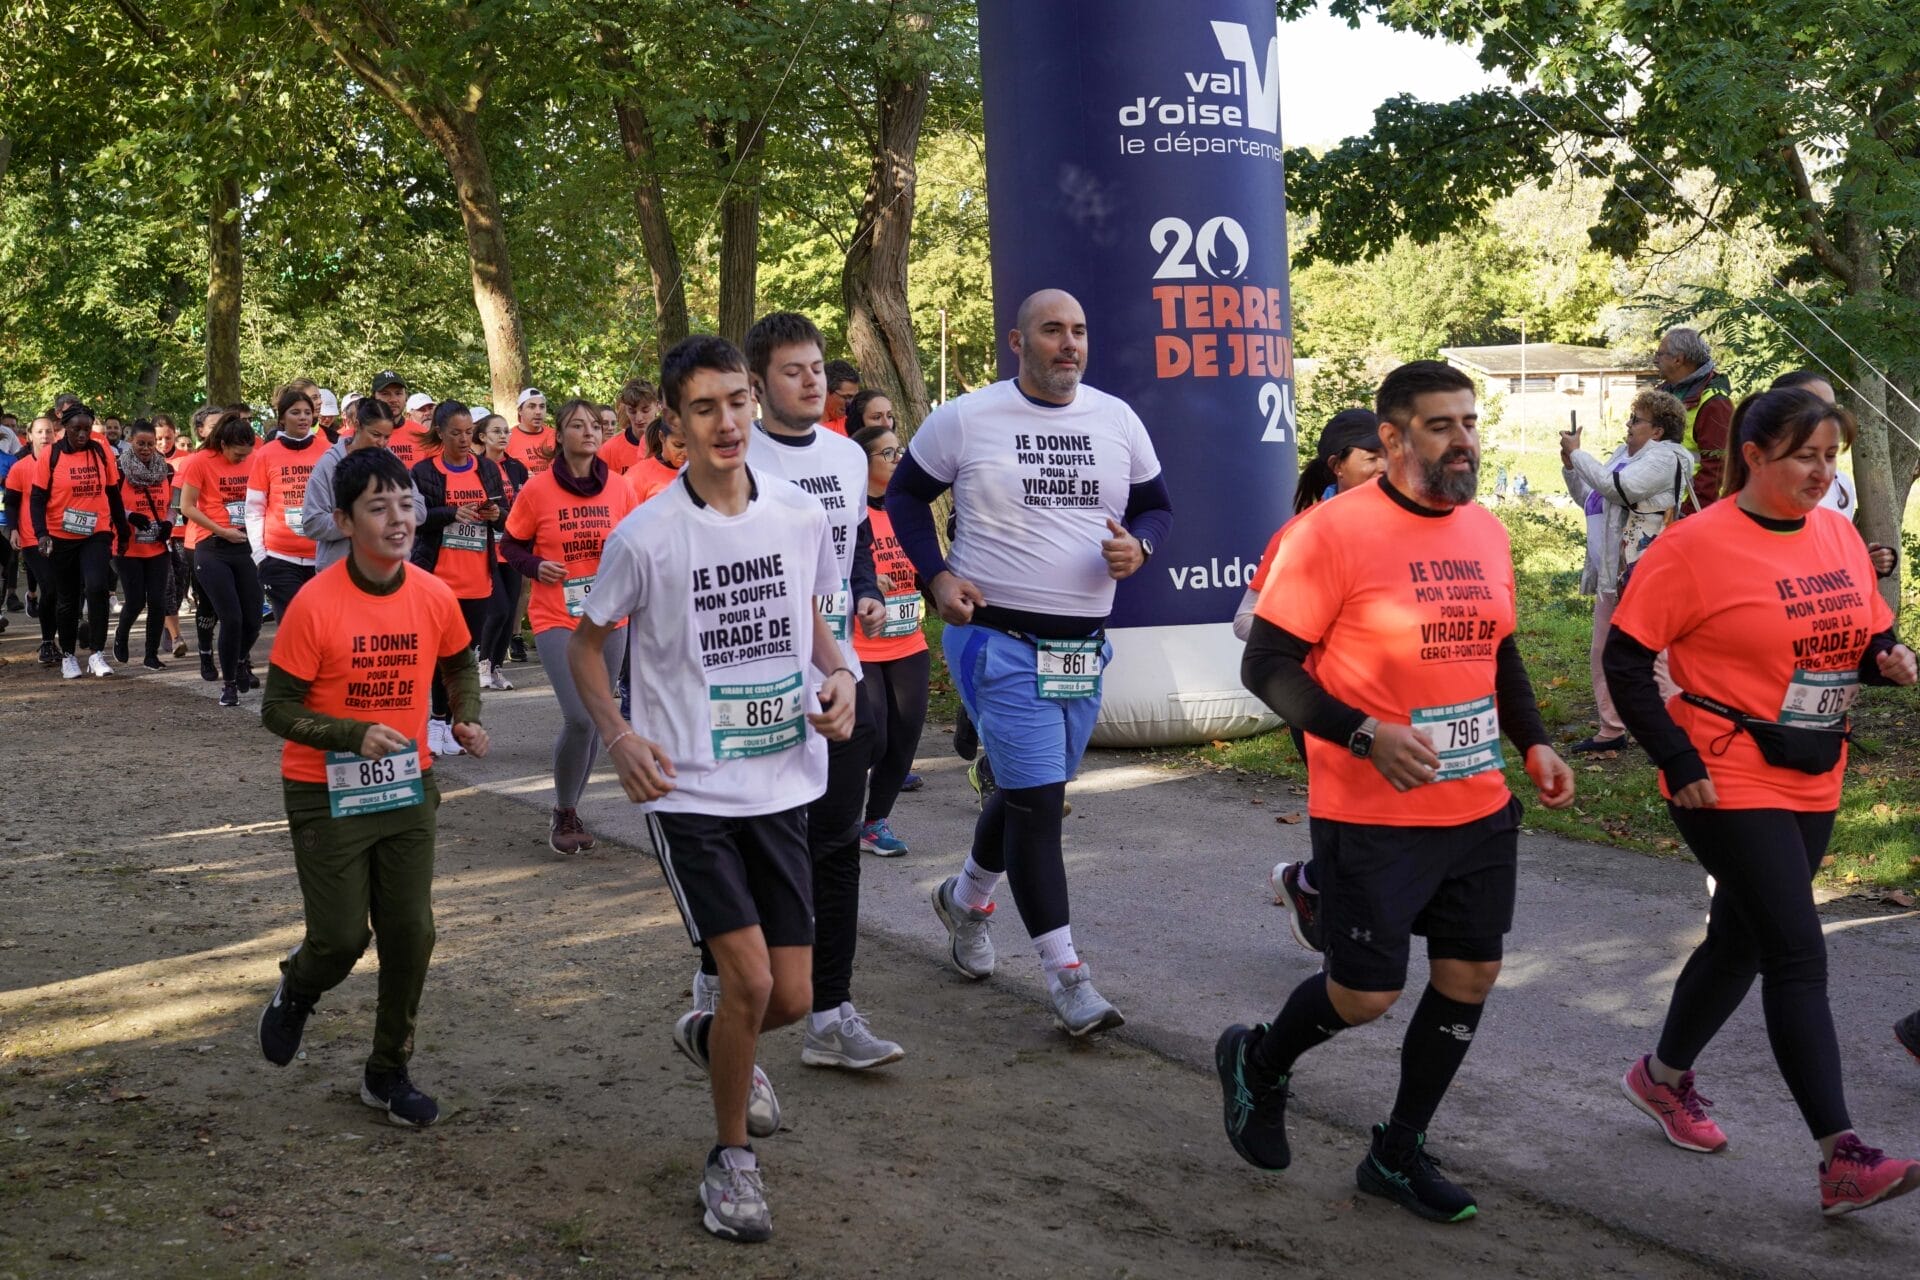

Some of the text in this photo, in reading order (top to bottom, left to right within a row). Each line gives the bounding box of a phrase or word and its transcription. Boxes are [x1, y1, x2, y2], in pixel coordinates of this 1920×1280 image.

[1184, 67, 1240, 95] val
[1118, 96, 1242, 126] d'oise
[1120, 131, 1283, 162] le départeme
[1152, 285, 1281, 329] TERRE
[1155, 334, 1219, 378] DE
[1015, 434, 1092, 451] JE DONNE
[1018, 453, 1096, 466] MON SOUFFLE
[281, 466, 289, 475] JE
[1040, 467, 1079, 478] POUR LA
[790, 475, 841, 495] ONNE
[1022, 479, 1099, 495] VIRADE DE
[454, 490, 484, 499] DONNE
[1024, 495, 1100, 506] CERGY-PONTOISE
[558, 506, 610, 521] JE DONNE
[458, 524, 476, 537] 806
[559, 520, 611, 532] MON SOUFFLE
[573, 531, 592, 539] POUR
[832, 525, 847, 543] DE
[562, 540, 598, 554] VIRADE
[877, 551, 894, 562] MON
[693, 554, 783, 592] JE DONNE
[1168, 555, 1264, 590] valdo
[1409, 560, 1485, 582] JE DONNE
[1775, 569, 1855, 600] JE DONNE
[694, 581, 787, 612] MON SOUFFLE
[1415, 585, 1493, 603] MON SOUFFLE
[900, 603, 915, 619] 817
[1441, 606, 1478, 618] POUR LA
[1785, 592, 1863, 620] MON SOUFFLE
[719, 606, 766, 625] POUR LA
[1812, 614, 1853, 632] POUR LA
[699, 617, 791, 652] VIRADE DE
[1421, 620, 1497, 644] VIRADE DE
[352, 633, 418, 652] JE DONNE
[1421, 642, 1492, 660] CERGY-PONTOISE
[1792, 630, 1850, 657] VIRADE
[352, 653, 417, 668] MON SOUFFLE
[1063, 653, 1086, 674] 861
[367, 669, 399, 680] POUR LA
[347, 680, 414, 697] VIRADE DE
[345, 696, 411, 709] CERGY-PONTOISE
[746, 697, 784, 727] 862
[769, 734, 774, 743] 6
[1447, 717, 1479, 748] 796
[359, 759, 395, 786] 863
[382, 792, 387, 800] 6
